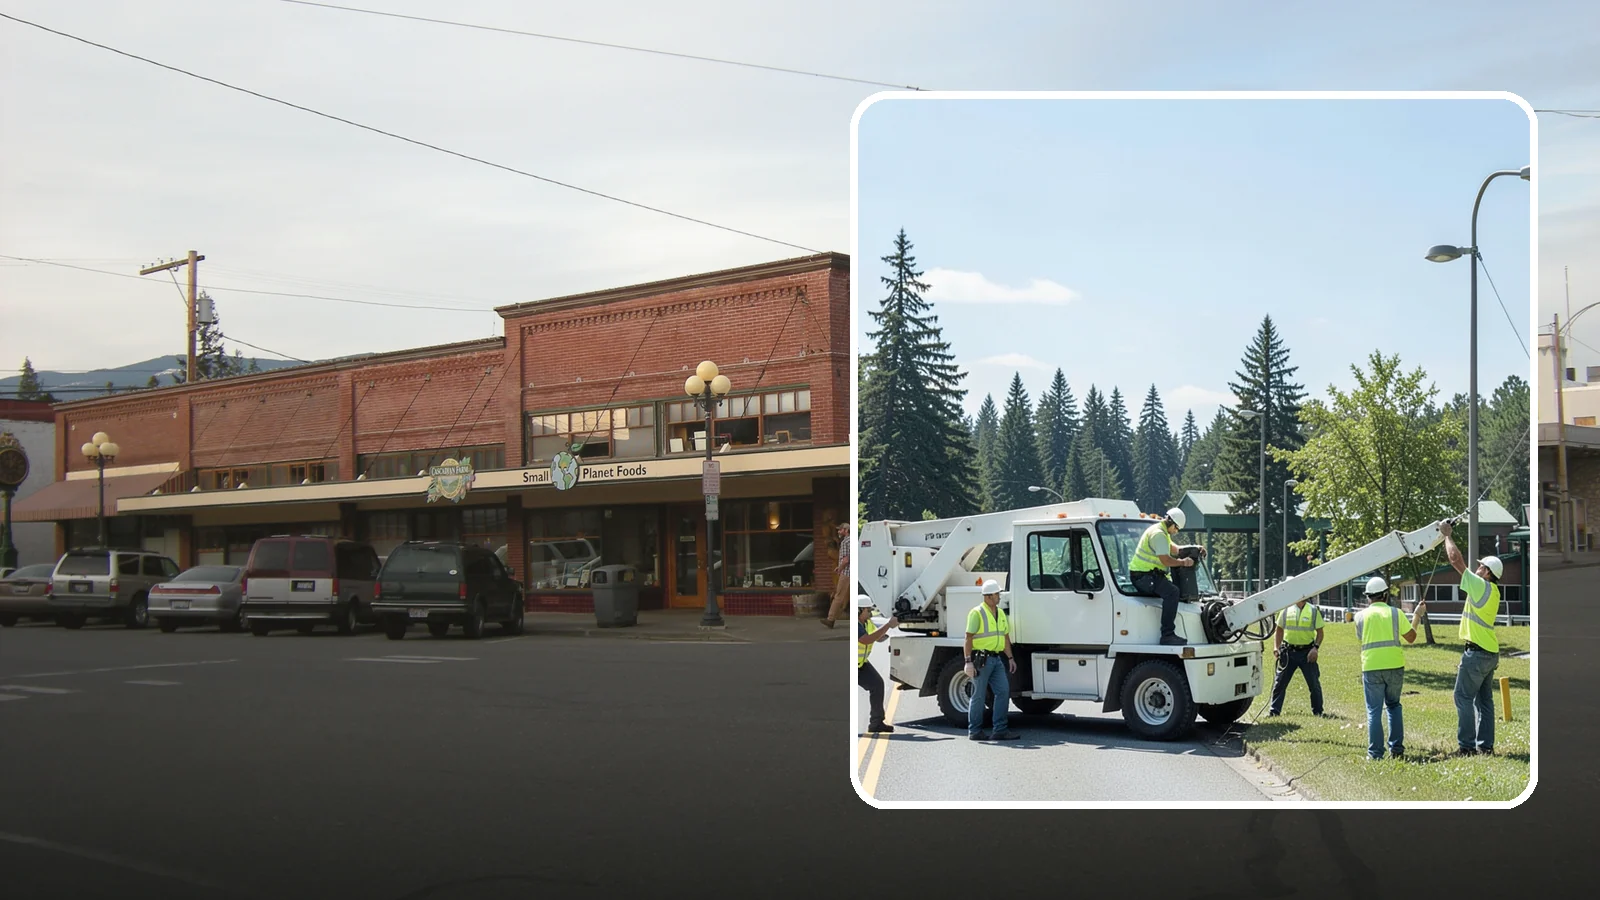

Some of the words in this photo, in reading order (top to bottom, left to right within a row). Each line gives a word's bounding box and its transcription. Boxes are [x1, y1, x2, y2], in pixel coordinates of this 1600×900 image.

[523, 471, 549, 483] Small
[583, 466, 614, 479] Planet
[616, 464, 647, 477] Foods
